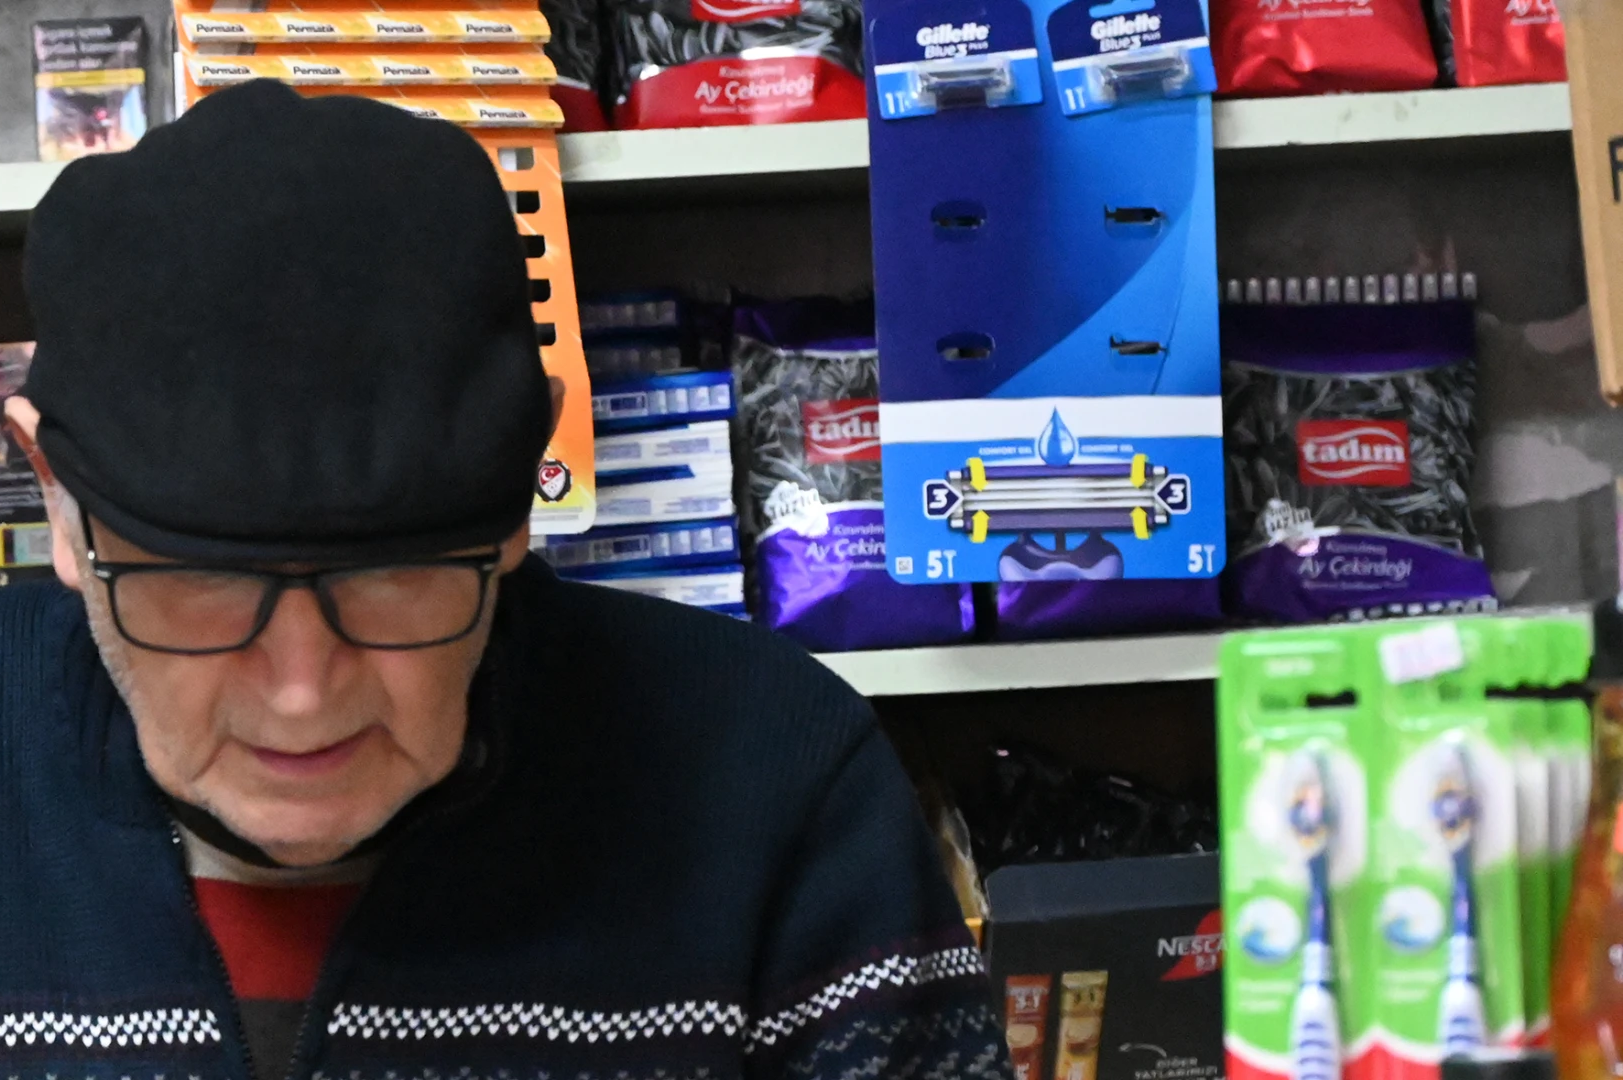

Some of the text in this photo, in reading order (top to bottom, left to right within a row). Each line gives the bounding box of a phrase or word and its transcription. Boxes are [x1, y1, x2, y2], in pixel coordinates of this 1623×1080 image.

[196, 23, 245, 34] Permatik
[286, 23, 336, 34] Permatik
[376, 23, 425, 34] Permatik
[466, 23, 514, 34] Permatik
[1091, 14, 1162, 41] Gillette
[916, 22, 991, 46] Gillette
[202, 65, 251, 76] Permatik
[293, 65, 342, 76] Permatik
[383, 65, 431, 76] Permatik
[472, 65, 520, 76] Permatik
[694, 80, 720, 105] Ay
[479, 109, 528, 119] Permatik
[978, 446, 1033, 456] COMFORT GEL
[1080, 444, 1135, 454] COMFORT GEL
[1303, 437, 1407, 464] tadım
[1166, 483, 1185, 504] 3
[928, 489, 950, 510] 3
[804, 542, 830, 562] Ay
[1297, 556, 1414, 581] Ay Çekirdeği
[1156, 933, 1228, 958] NESCA
